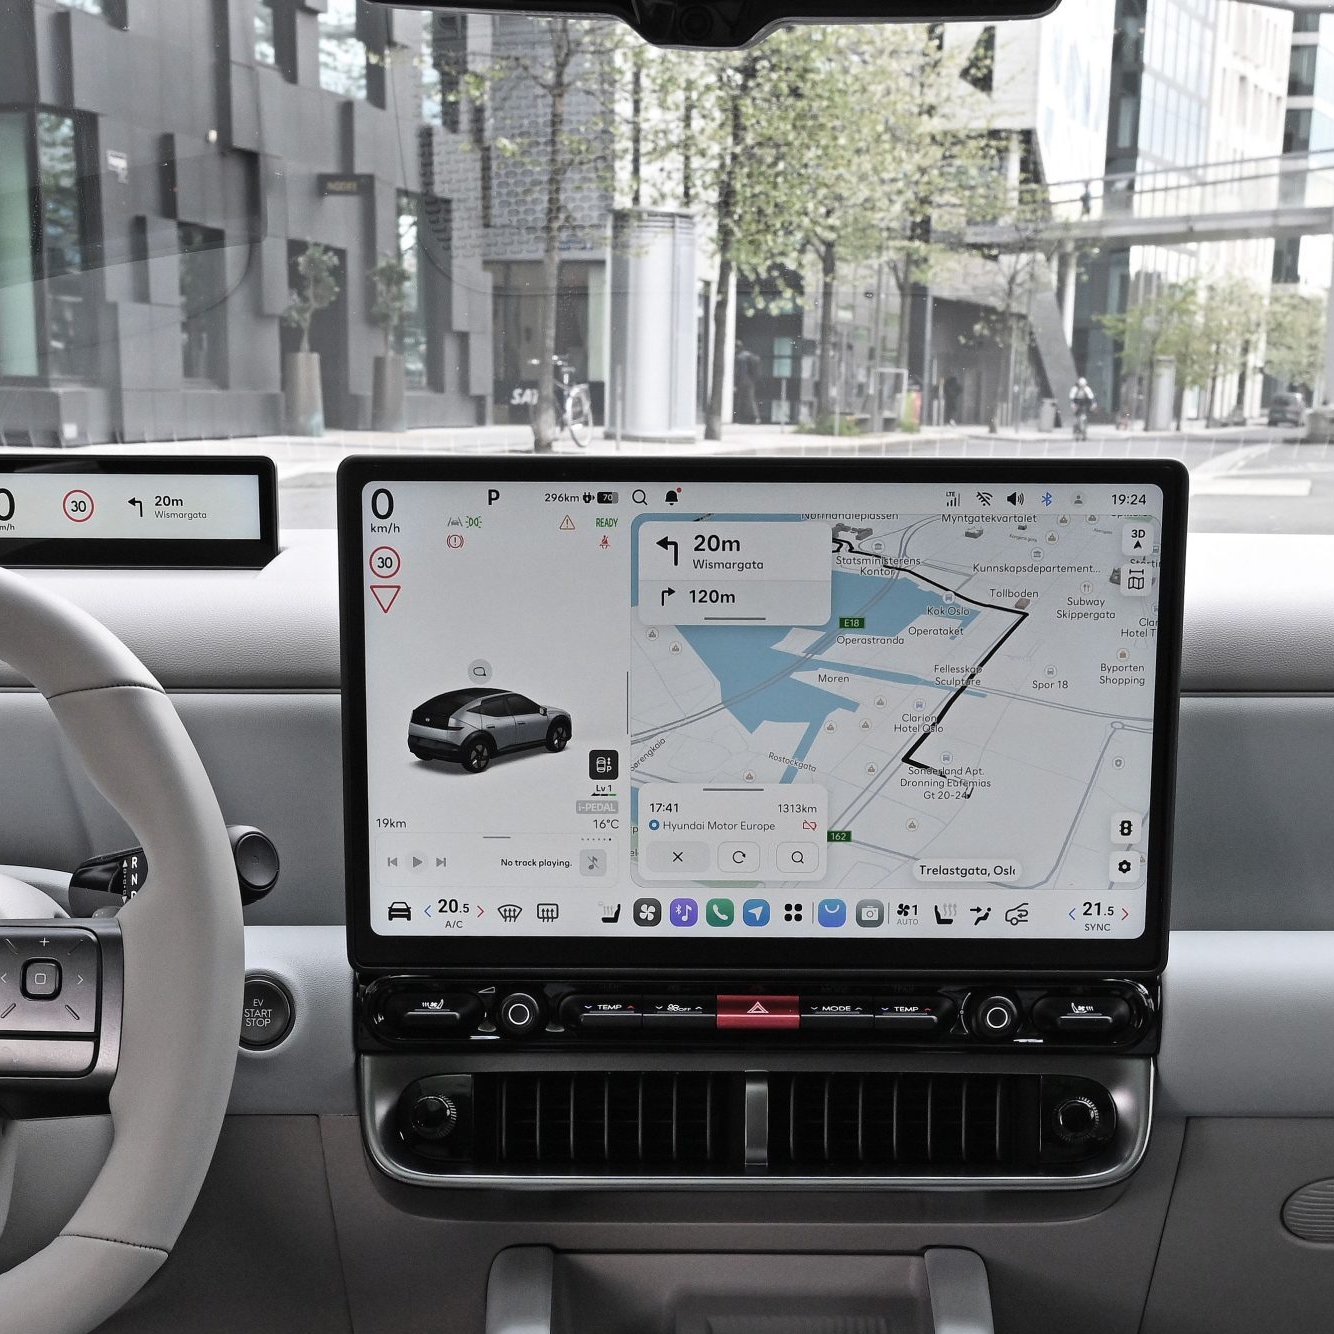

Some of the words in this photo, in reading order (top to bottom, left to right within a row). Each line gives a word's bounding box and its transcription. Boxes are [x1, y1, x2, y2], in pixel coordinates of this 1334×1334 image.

[154, 495, 184, 507] 20m
[487, 489, 500, 506] P
[544, 493, 580, 503] 296km
[1111, 494, 1147, 506] 19:24
[70, 500, 87, 513] 30
[371, 488, 394, 520] 0
[154, 510, 207, 521] Wismargata
[941, 514, 1037, 525] Myntgatekvartalet
[370, 522, 400, 534] km/h
[595, 517, 619, 528] READY
[1131, 529, 1146, 539] 3D
[693, 535, 741, 552] 20m
[377, 556, 393, 569] 30
[693, 559, 764, 572] Wismargata
[835, 555, 921, 566] Statsministerens
[860, 566, 895, 576] Kontor
[689, 589, 736, 604] 120m
[989, 589, 1039, 599] Tollboden
[1066, 597, 1106, 608] Subway
[927, 606, 945, 616] Kok
[946, 606, 970, 616] Oslo
[1056, 610, 1116, 622] Skippergata
[844, 617, 860, 627] E18
[908, 626, 964, 637] Operataket
[1121, 628, 1148, 638] Hotel
[836, 635, 905, 646] Operastranda
[934, 664, 983, 675] Fellesskap
[1100, 663, 1145, 674] Byporten
[818, 674, 850, 684] Moren
[935, 677, 981, 688] Sculpture
[1099, 676, 1145, 687] Shopping
[1032, 680, 1054, 690] Spor
[1057, 680, 1069, 689] 18
[901, 713, 937, 723] Clarion
[894, 724, 920, 733] Hotel
[922, 724, 944, 733] Oslo
[768, 751, 817, 773] Rostockgata
[965, 766, 984, 776] Apt.
[596, 784, 606, 792] Lv
[608, 784, 612, 792] 1
[900, 778, 945, 789] Dronning
[923, 791, 935, 800] Gt
[937, 791, 967, 800] 20-24
[649, 803, 679, 813] 17:41
[777, 804, 817, 814] 1313km
[376, 818, 407, 829] 19km
[593, 819, 620, 829] 16°C
[663, 821, 705, 832] Hyundai
[707, 821, 738, 831] Motor
[740, 821, 776, 832] Europe
[831, 832, 846, 841] 162
[131, 856, 138, 869] R
[500, 858, 513, 867] No
[514, 858, 537, 867] track
[538, 858, 573, 869] playing.
[919, 865, 991, 878] Trelastgata,
[131, 873, 138, 886] N
[437, 898, 470, 914] 20.5
[912, 904, 919, 916] 1
[1082, 901, 1115, 916] 21.5
[445, 920, 464, 929] A/C
[896, 918, 919, 926] AUTO
[1084, 923, 1111, 932] SYNC
[253, 998, 264, 1007] EV
[243, 1008, 273, 1018] START
[893, 1005, 919, 1013] TEMP
[245, 1018, 271, 1027] STOP
